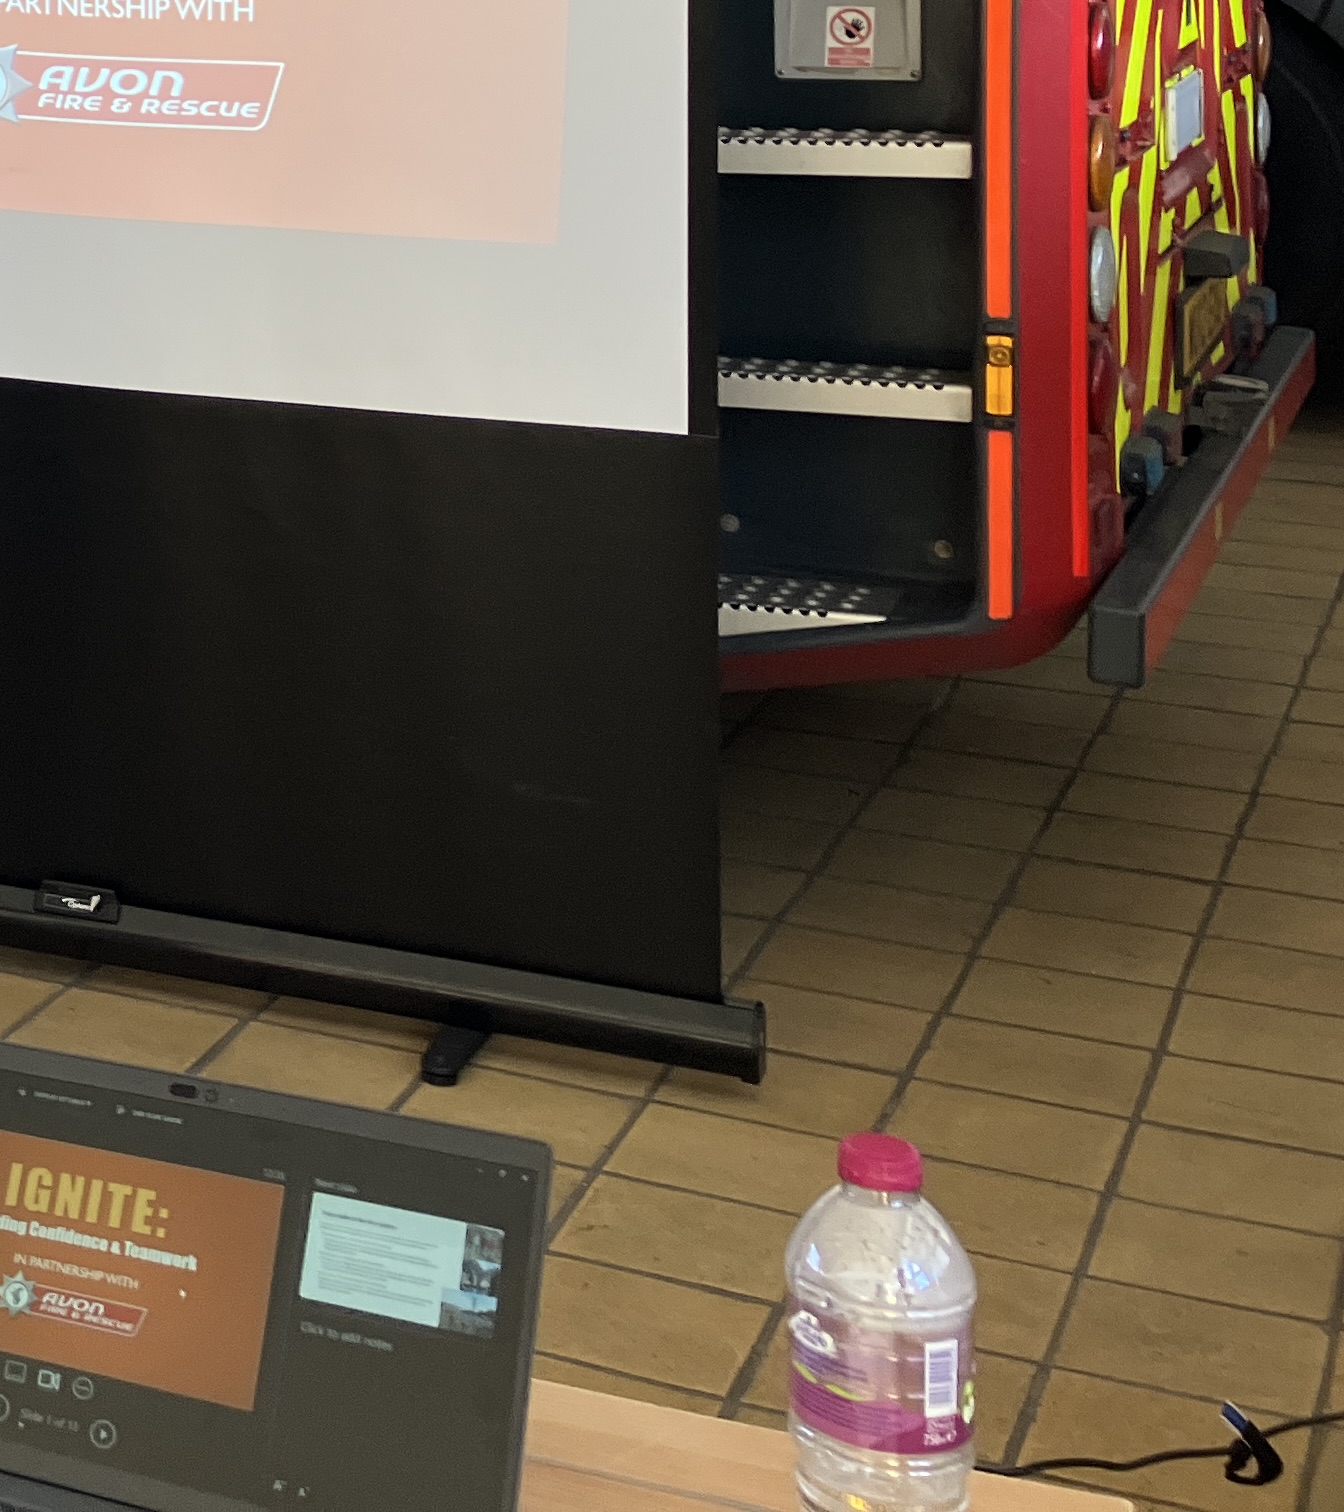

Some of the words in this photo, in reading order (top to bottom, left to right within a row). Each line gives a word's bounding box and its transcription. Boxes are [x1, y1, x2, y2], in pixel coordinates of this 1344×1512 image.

[38, 65, 184, 96] AVON
[37, 93, 101, 112] FIRE
[111, 97, 133, 114] &
[140, 99, 261, 118] RESCUE
[5, 1162, 169, 1238] IGNITE:
[29, 1220, 109, 1251] Confidence
[124, 1241, 198, 1272] Teamwork
[14, 1253, 26, 1265] IN
[29, 1256, 105, 1281] PARTNERSHIP
[106, 1274, 139, 1289] WITH
[42, 1292, 104, 1316] AVON
